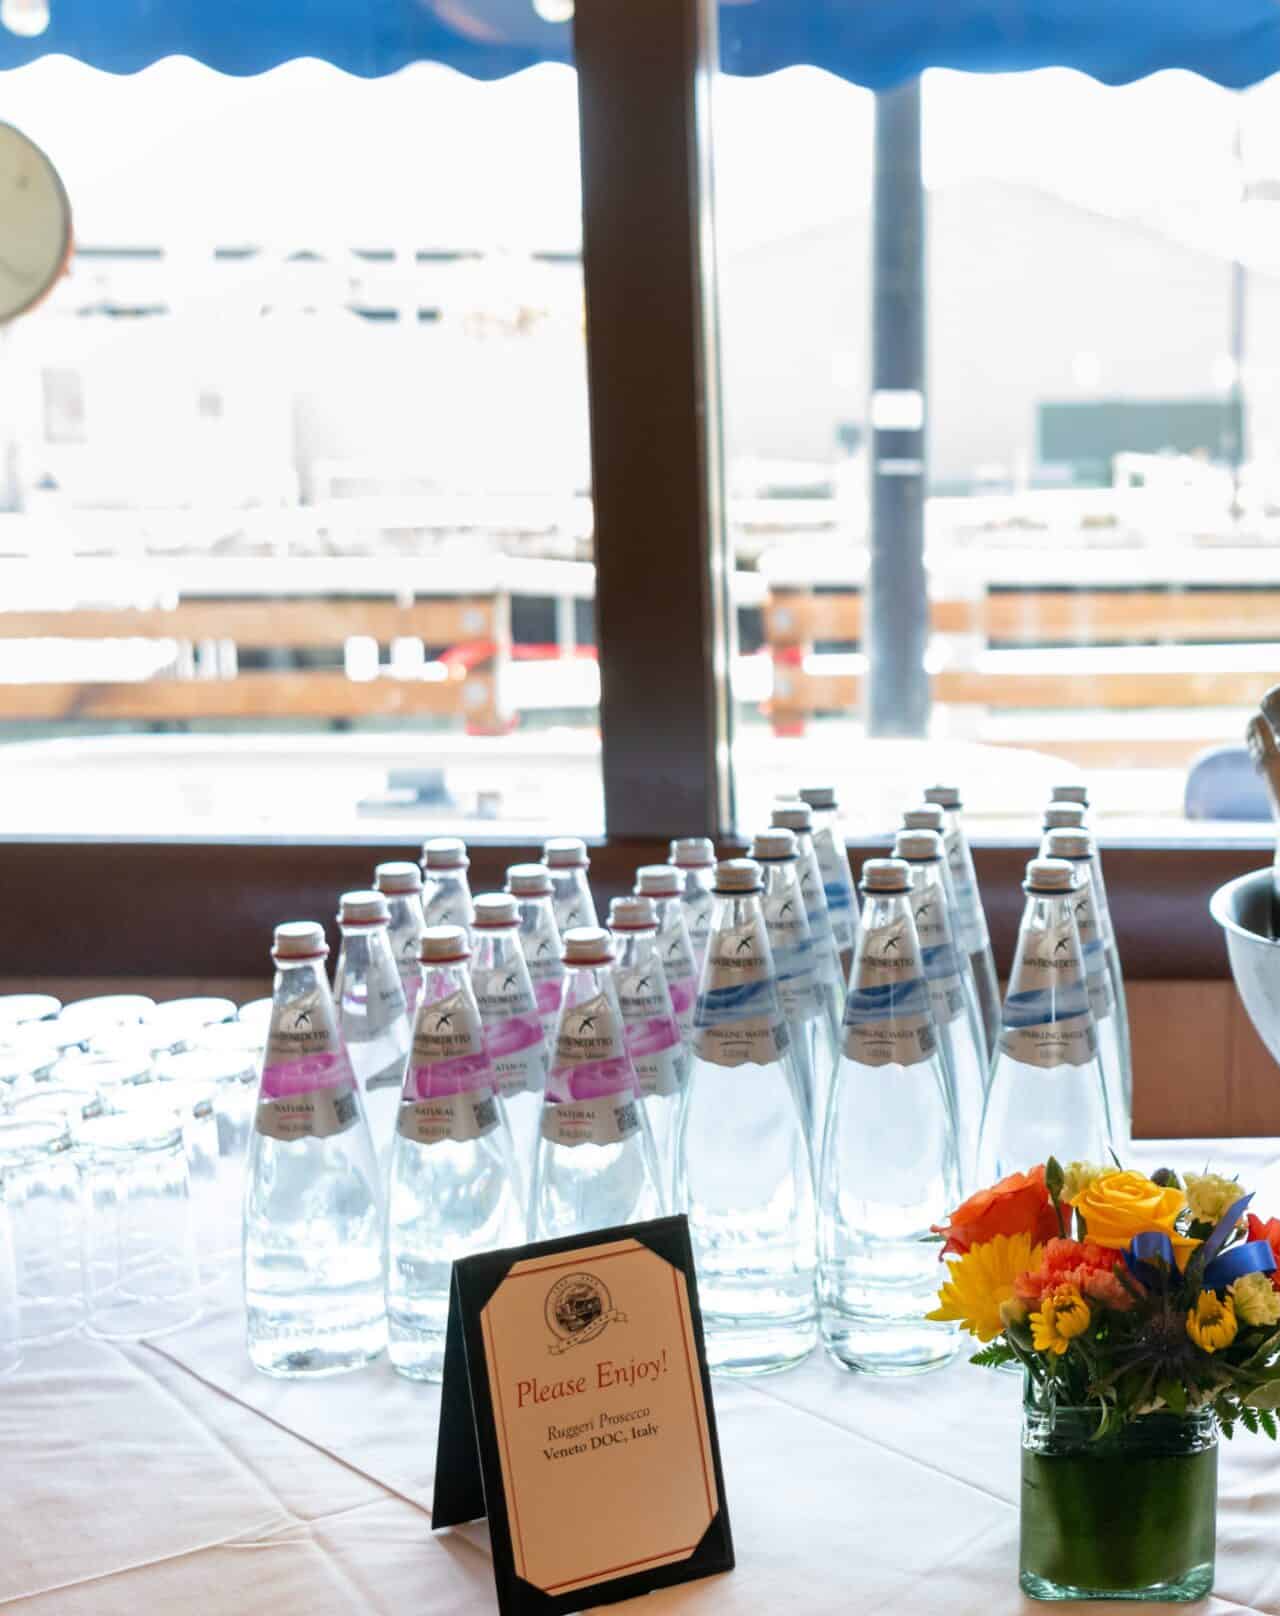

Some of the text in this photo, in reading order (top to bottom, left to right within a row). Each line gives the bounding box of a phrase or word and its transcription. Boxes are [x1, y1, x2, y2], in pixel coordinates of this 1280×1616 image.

[516, 1348, 668, 1408] Please Enjoy!
[599, 1408, 650, 1429] Prosecco
[542, 1423, 659, 1461] Veneto DOC, Italy
